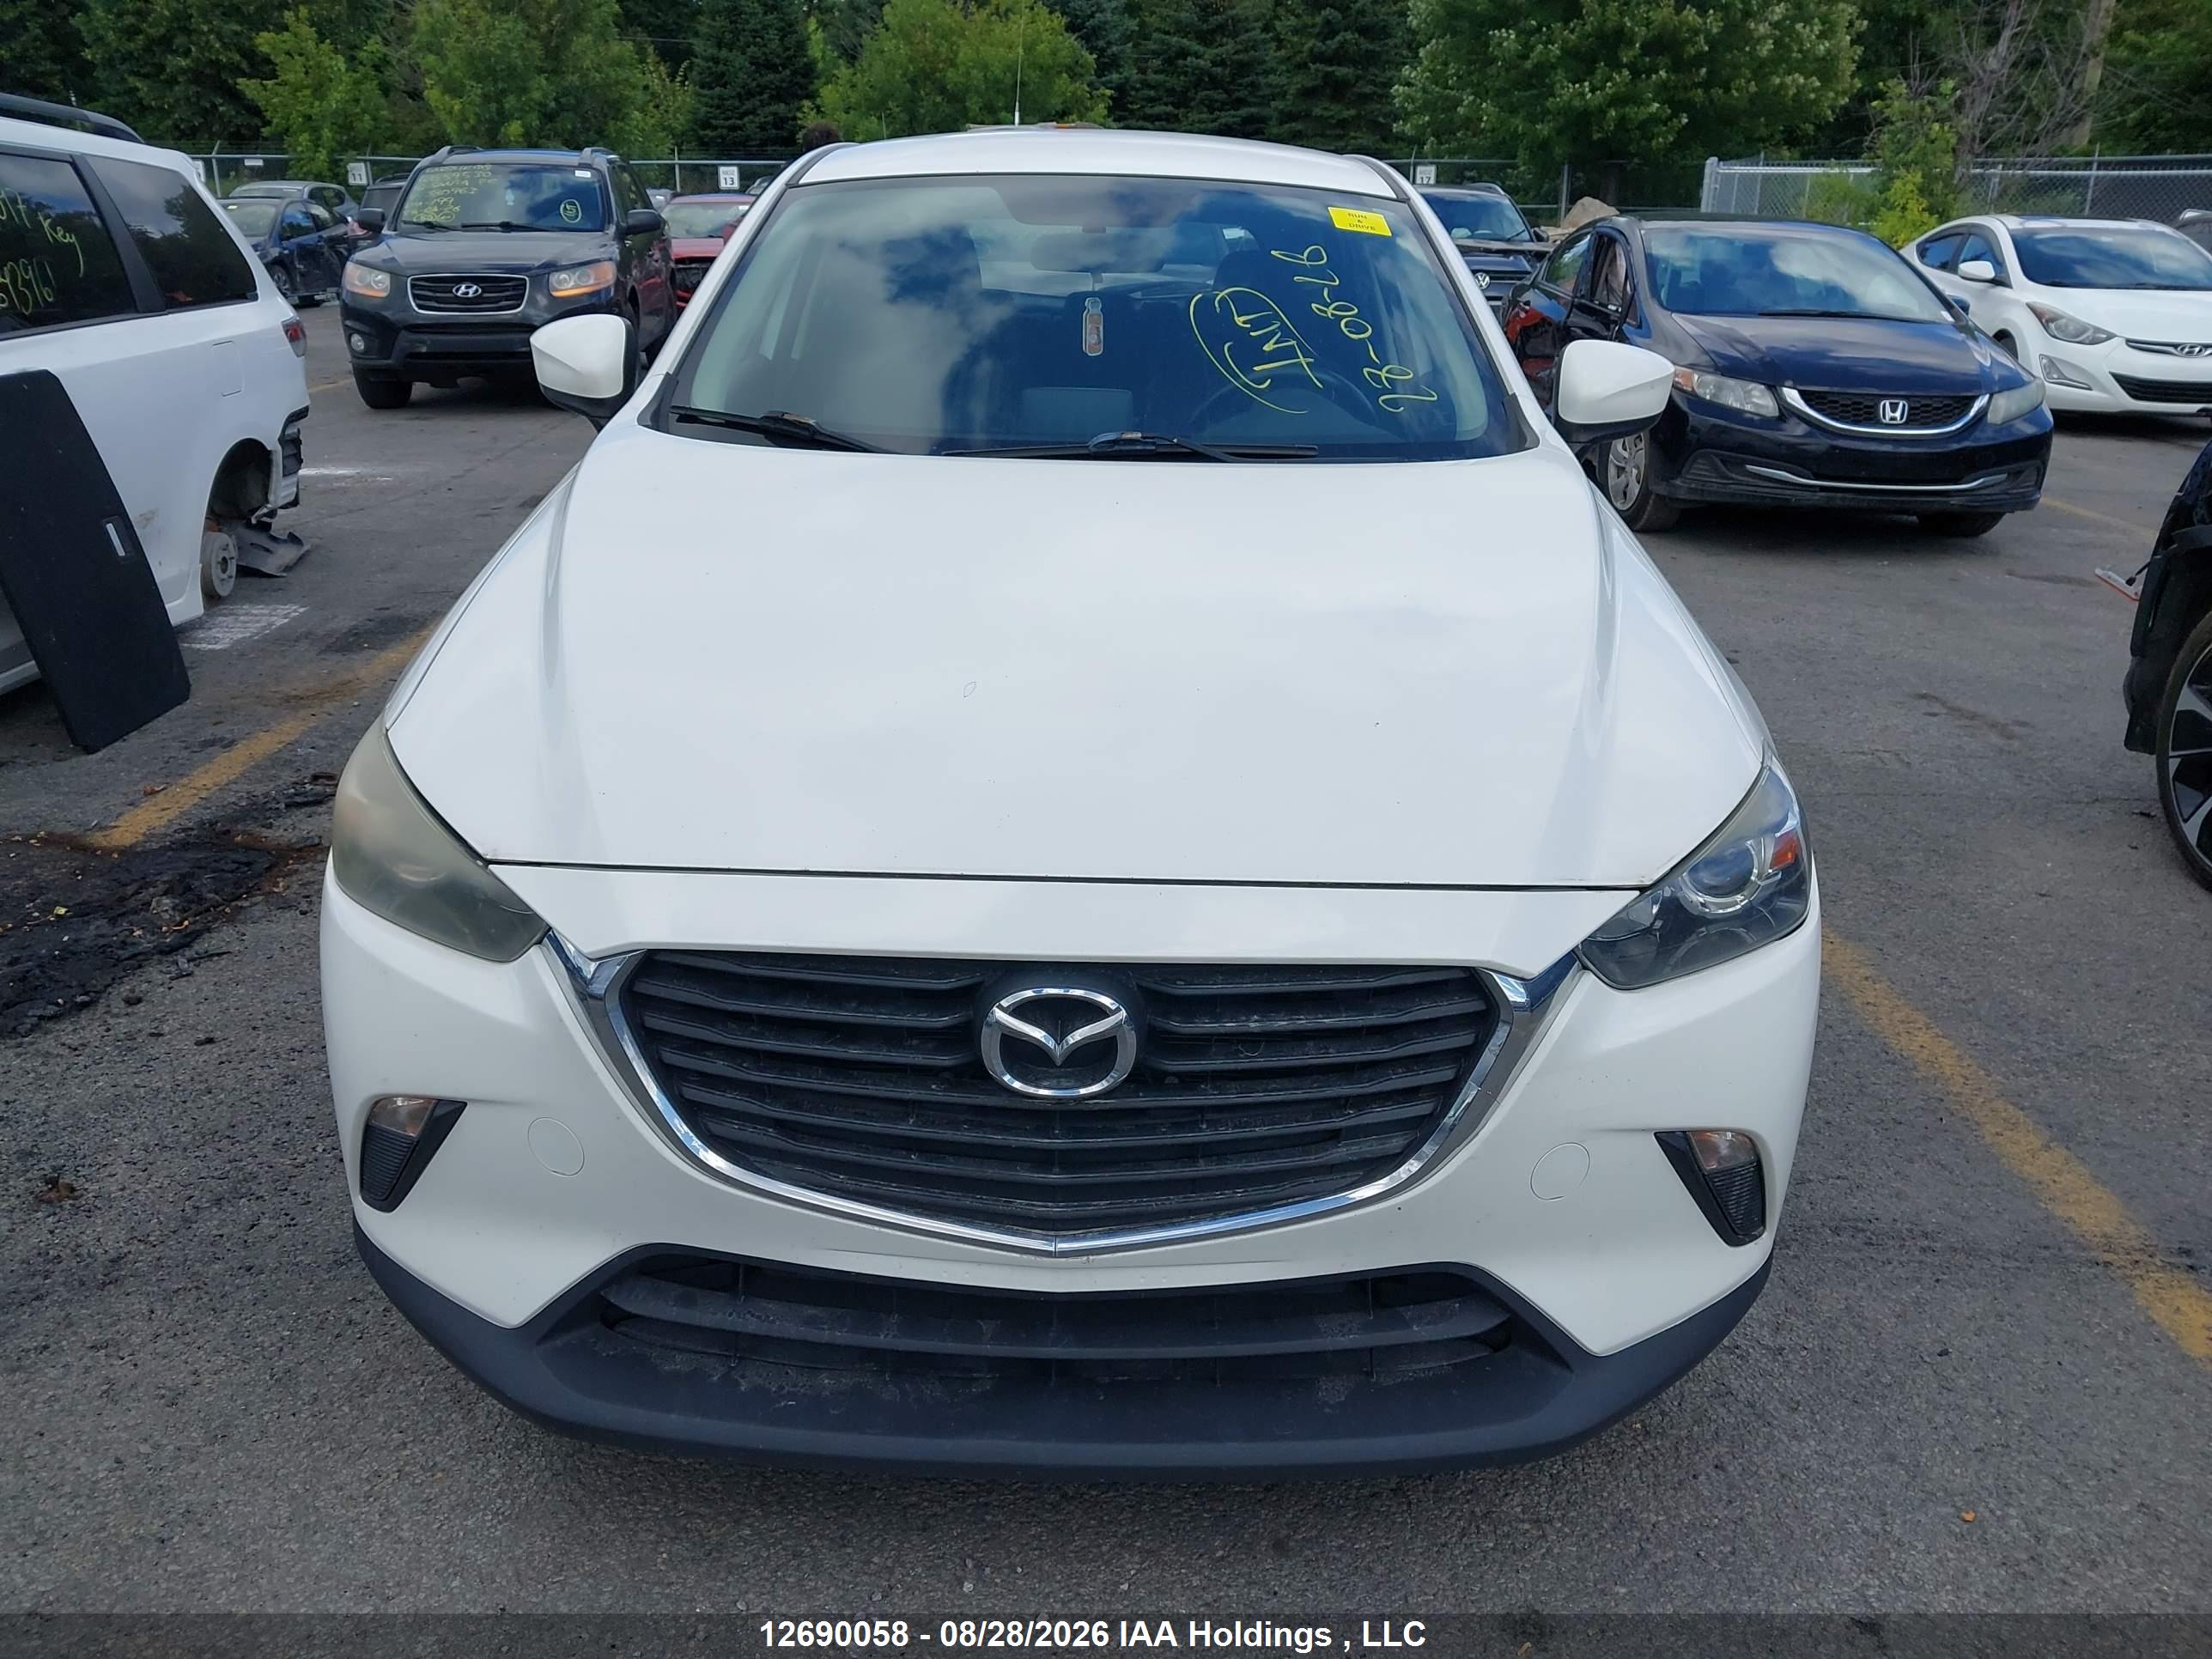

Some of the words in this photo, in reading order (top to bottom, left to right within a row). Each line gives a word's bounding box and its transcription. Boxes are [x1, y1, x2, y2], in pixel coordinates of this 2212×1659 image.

[350, 173, 363, 182] 11
[723, 177, 736, 186] 13
[1419, 176, 1431, 185] 17
[38, 212, 84, 277] Key
